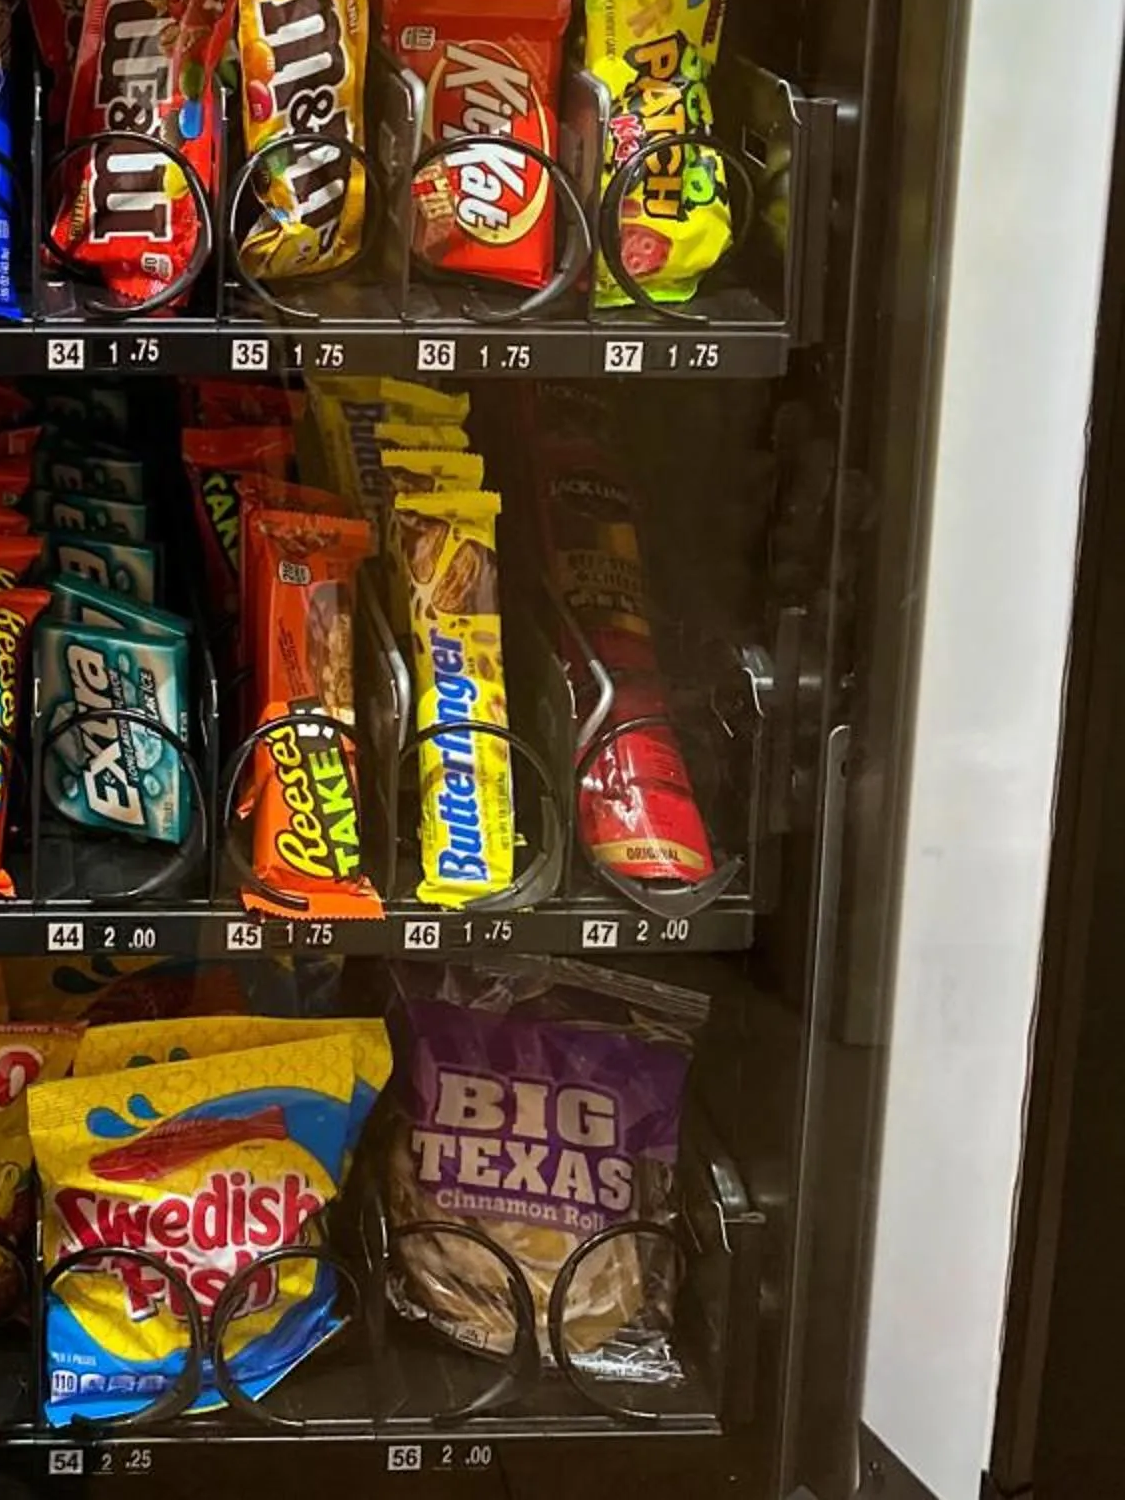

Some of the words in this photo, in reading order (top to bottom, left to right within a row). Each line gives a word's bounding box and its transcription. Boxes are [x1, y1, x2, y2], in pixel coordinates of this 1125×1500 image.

[634, 40, 686, 216] PATCH
[52, 342, 80, 365] 34
[236, 343, 264, 365] 35
[422, 343, 451, 366] 36
[610, 345, 639, 367] 37
[65, 643, 146, 827] Extra
[275, 725, 335, 880] Reese's
[309, 745, 361, 880] TAKE
[52, 926, 80, 947] 44
[231, 925, 259, 947] 45
[408, 925, 436, 946] 46
[586, 923, 614, 944] 47
[433, 1070, 620, 1149] BIG
[411, 1130, 635, 1212] TEXAS
[56, 1170, 327, 1253] Swedish
[436, 1187, 558, 1223] Cinnamon
[115, 1244, 279, 1323] Fish
[53, 1373, 75, 1392] 110
[54, 1452, 79, 1471] 54
[392, 1448, 418, 1467] 56
